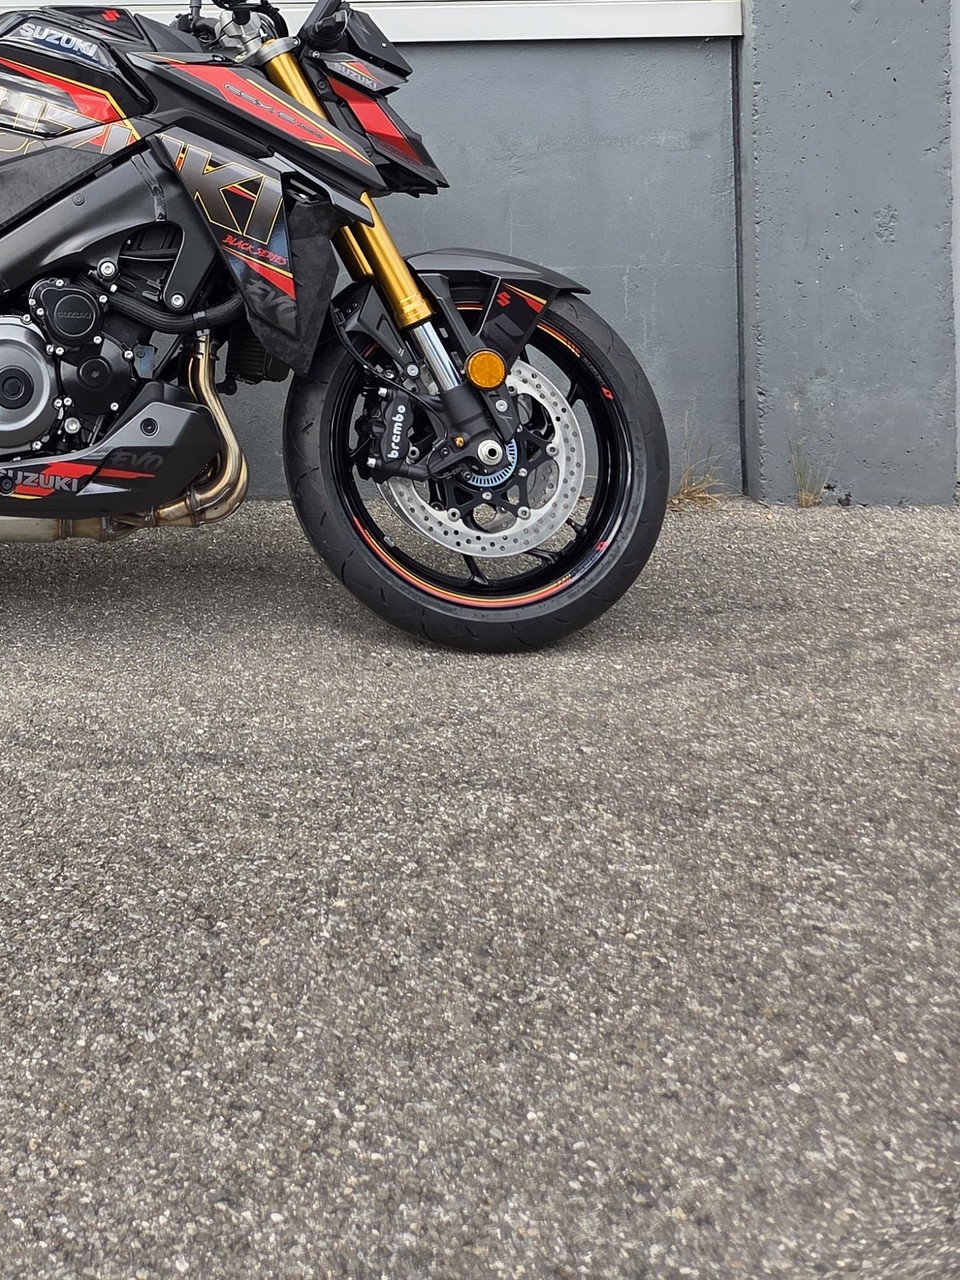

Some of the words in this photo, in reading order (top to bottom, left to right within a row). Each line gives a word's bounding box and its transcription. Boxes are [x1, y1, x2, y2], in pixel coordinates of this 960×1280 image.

[19, 22, 99, 58] SUZUKI
[333, 62, 378, 90] SUZUKI
[222, 234, 255, 254] BLACK
[253, 247, 289, 266] SERIES
[387, 404, 407, 460] brembo
